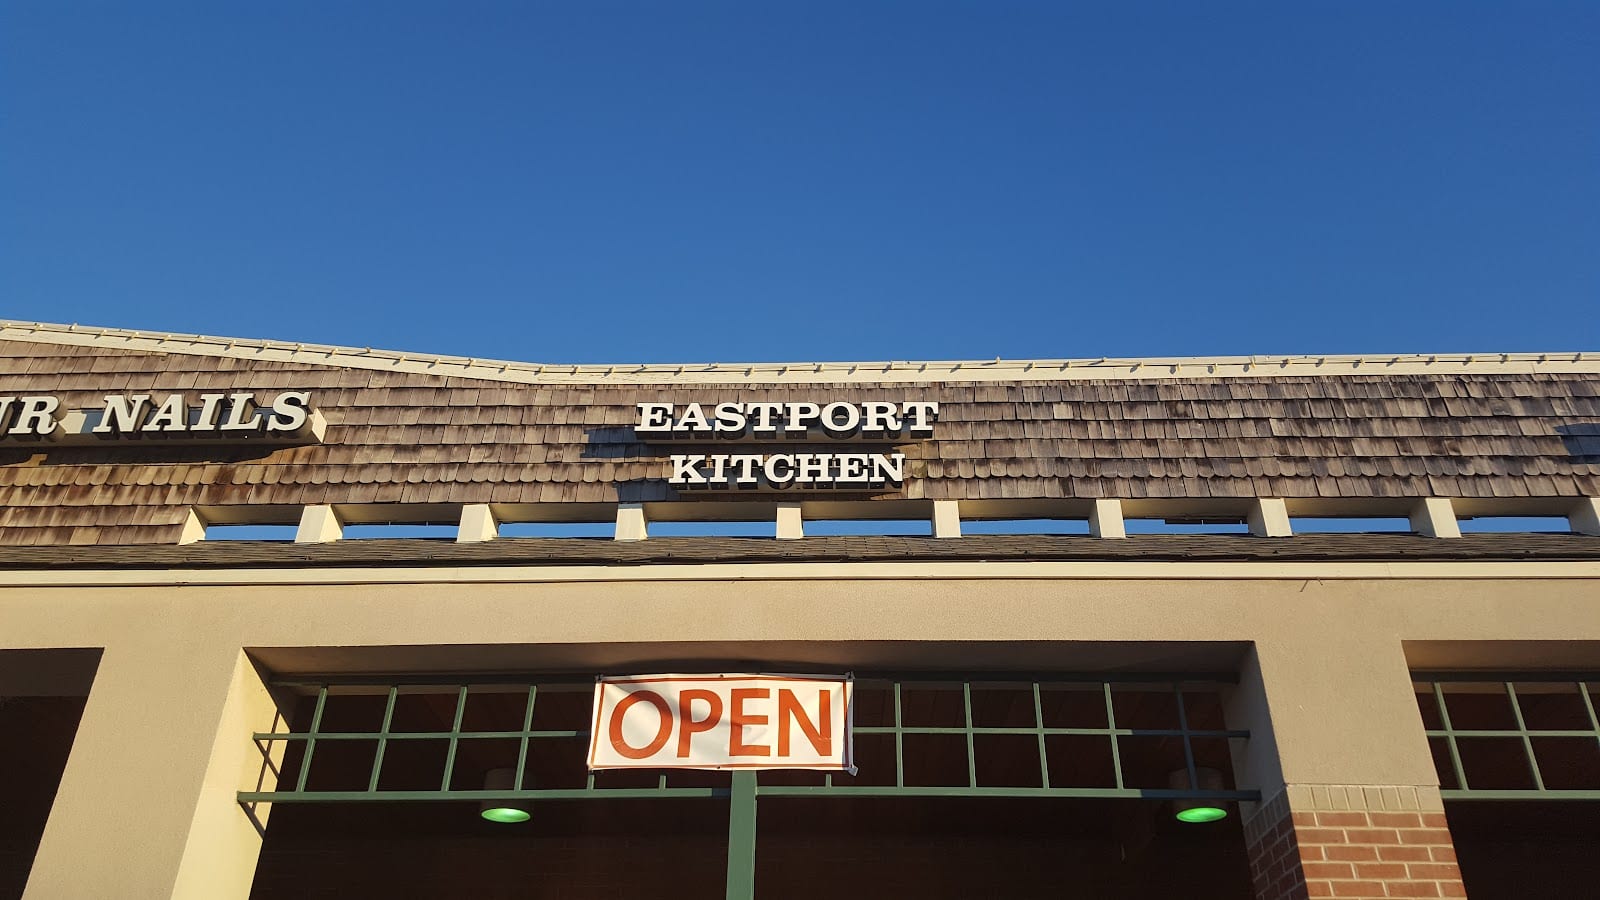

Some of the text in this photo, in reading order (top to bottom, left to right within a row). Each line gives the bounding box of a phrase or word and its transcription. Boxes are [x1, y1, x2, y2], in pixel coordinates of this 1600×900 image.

[93, 391, 312, 433] NAILS
[634, 401, 939, 432] EASTPORT
[668, 453, 905, 483] KITCHEN
[608, 688, 832, 759] OPEN
